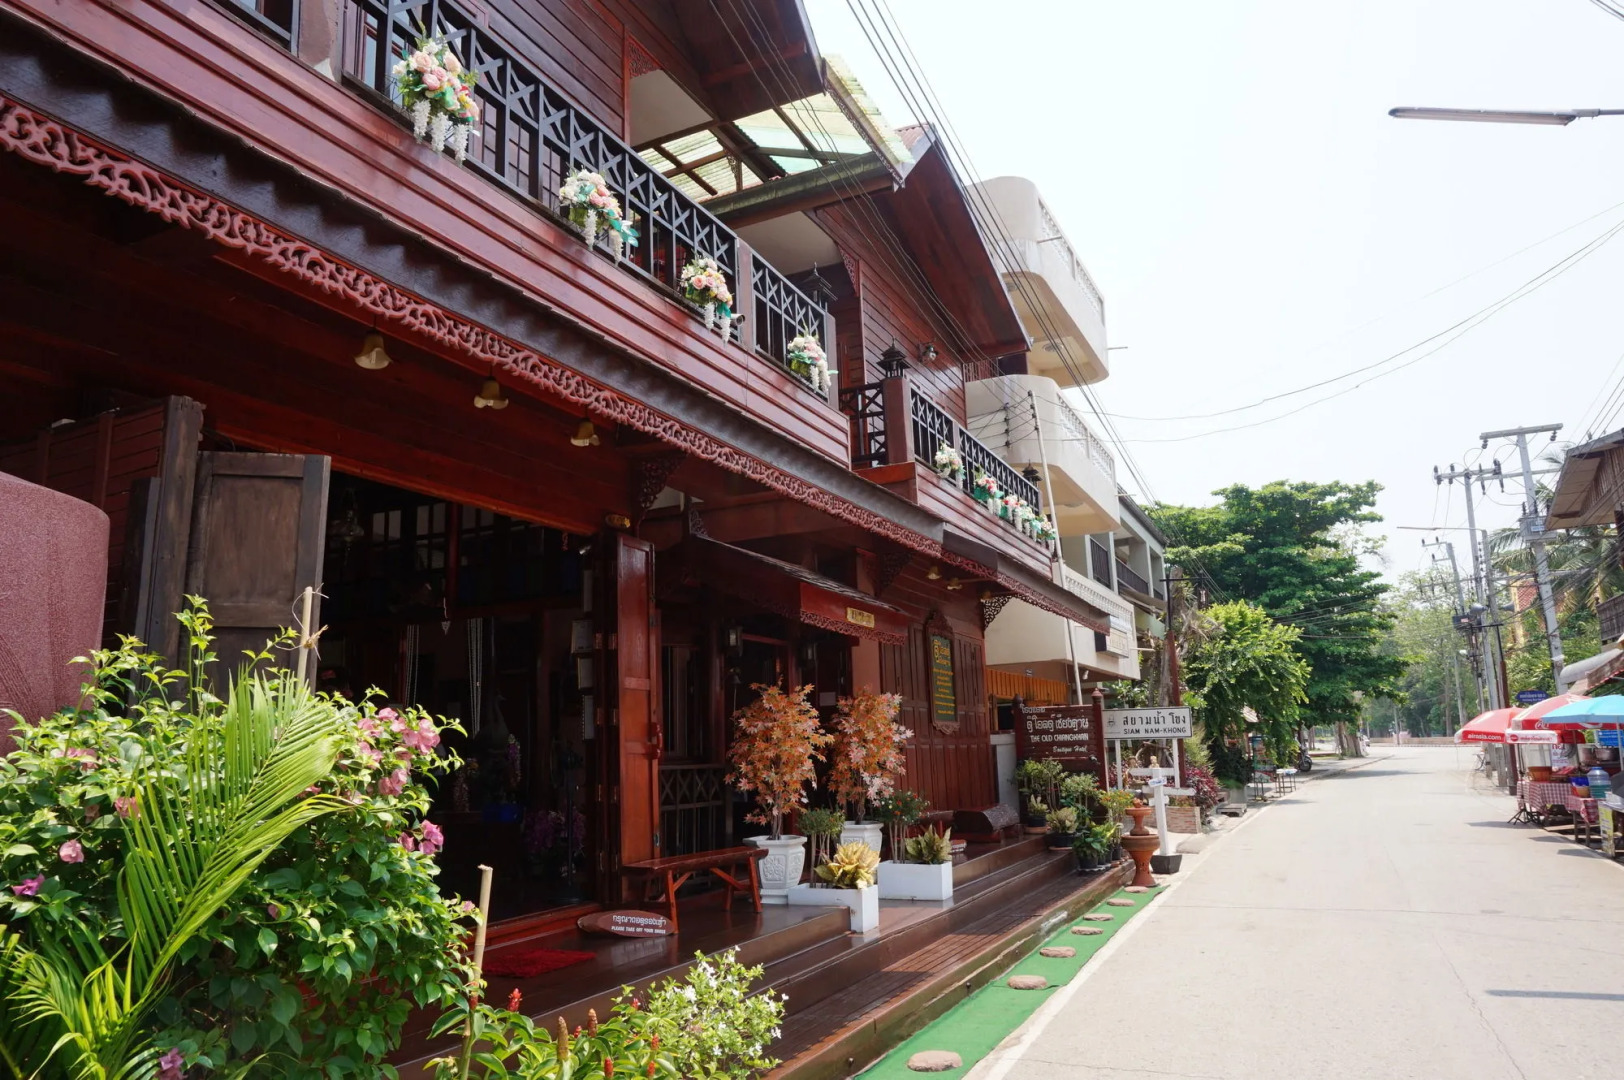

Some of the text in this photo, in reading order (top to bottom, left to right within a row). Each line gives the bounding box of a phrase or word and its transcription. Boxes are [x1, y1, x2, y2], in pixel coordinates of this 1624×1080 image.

[1144, 727, 1187, 735] NAM-KHONG
[1030, 733, 1089, 743] THE OLD CHIANGKHAN
[1467, 733, 1502, 741] airasia.com
[1052, 745, 1088, 754] Boutique Hotel
